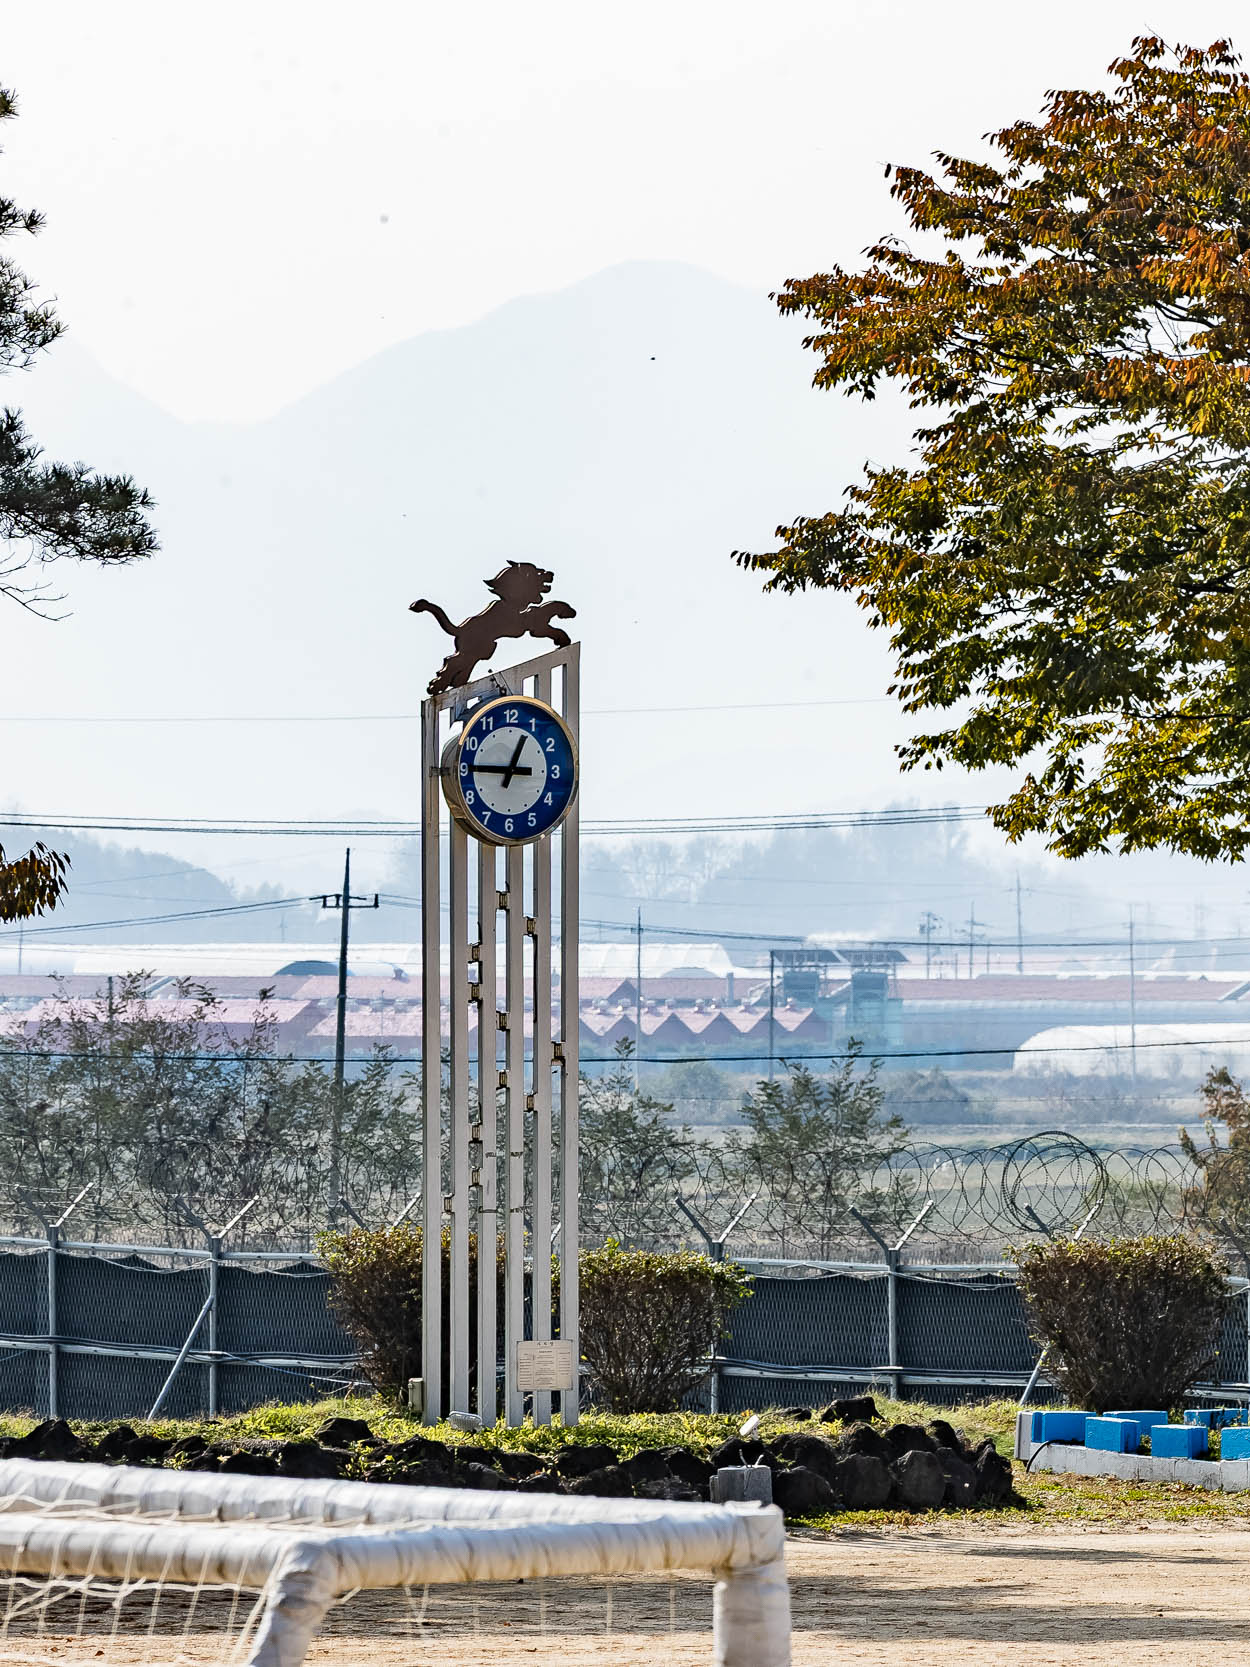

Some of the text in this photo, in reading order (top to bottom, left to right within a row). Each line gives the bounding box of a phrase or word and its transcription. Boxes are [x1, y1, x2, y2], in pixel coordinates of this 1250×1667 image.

[480, 716, 493, 730] 11
[504, 709, 519, 724] 12
[529, 718, 536, 732] 1
[465, 737, 478, 751] 10
[546, 738, 555, 752] 2
[460, 762, 469, 777] 9
[551, 765, 560, 779] 3
[465, 790, 475, 805] 8
[543, 791, 553, 806] 4
[482, 811, 492, 825] 7
[504, 818, 514, 832] 6
[527, 812, 537, 827] 5
